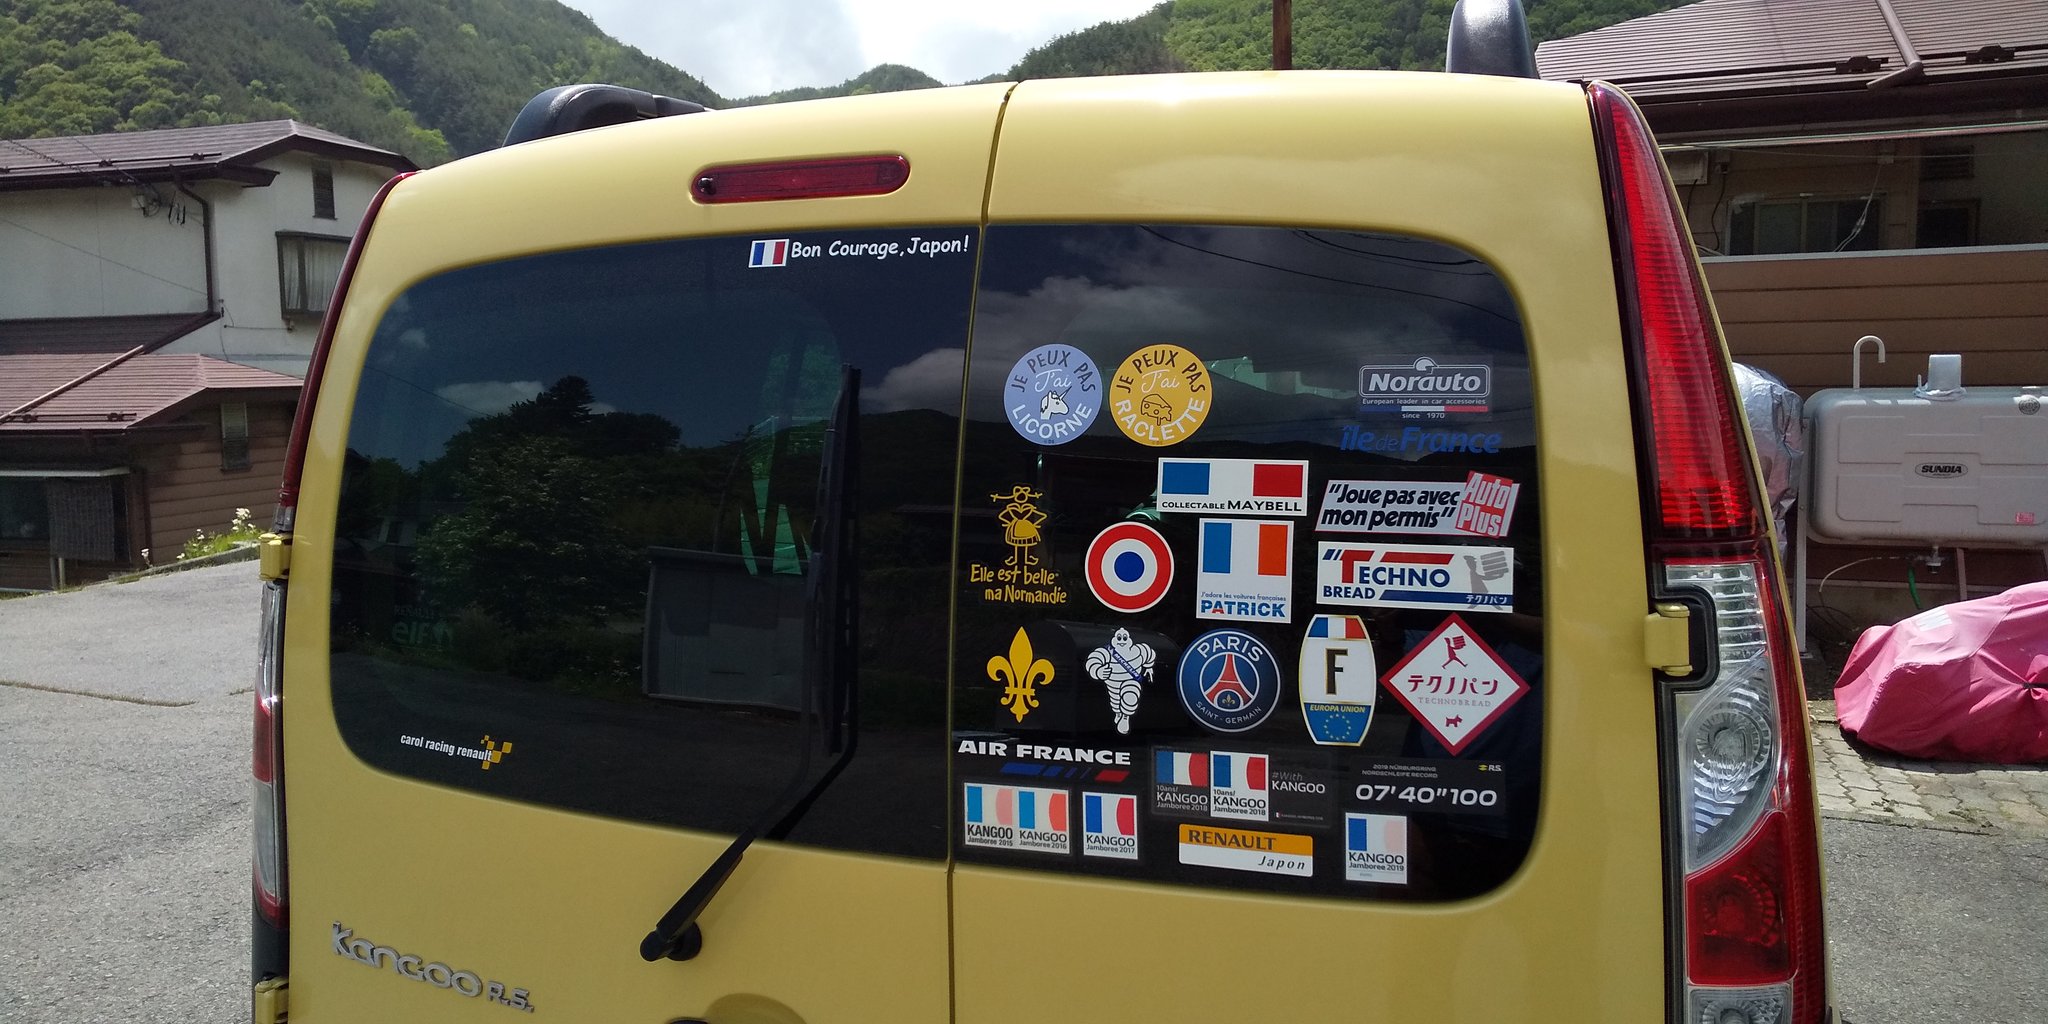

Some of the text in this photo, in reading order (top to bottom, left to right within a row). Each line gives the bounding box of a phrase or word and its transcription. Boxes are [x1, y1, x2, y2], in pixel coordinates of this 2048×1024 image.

[791, 241, 821, 258] Bon
[1011, 350, 1096, 393] JE PEUX PAS
[1116, 350, 1206, 393] JE PEUX PAS
[1035, 369, 1072, 393] J'ai
[1141, 369, 1180, 393] J'ai
[1368, 372, 1481, 392] Norauto
[1012, 403, 1092, 439] LICORNE
[1115, 398, 1206, 442] RACLETTE
[1400, 426, 1502, 453] France
[1921, 465, 1962, 473] SUNDIA
[1328, 484, 1461, 508] "Joue pas avec
[1464, 474, 1510, 509] Auto
[1162, 500, 1302, 512] COLLECTABLE MAYBELL
[1320, 506, 1456, 531] mon permis"
[1456, 503, 1502, 536] Plus
[970, 564, 1055, 585] Elle est belle
[1340, 549, 1451, 588] TECHNO
[985, 585, 1067, 604] ma Normandie
[1201, 591, 1222, 599] J'adore
[1257, 593, 1286, 602] françaises
[1323, 585, 1376, 600] BREAD
[1466, 595, 1507, 604] テクノパン
[1200, 600, 1286, 618] PATRICK
[1197, 636, 1263, 662] PARIS
[1114, 652, 1139, 678] MICHELIN
[1325, 648, 1349, 695] F
[1407, 675, 1498, 696] テクノパン
[1310, 704, 1366, 713] EUROPA UNION
[1417, 697, 1491, 707] TECHNOBREAD
[400, 734, 492, 762] carol racing renault
[958, 740, 1131, 766] AIR FRANCE
[1272, 771, 1303, 781] #With
[1272, 780, 1326, 794] KANGOO
[1156, 792, 1208, 805] KANGOO
[1156, 801, 1191, 810] Jamboree
[1213, 796, 1266, 809] KANGOO
[1213, 806, 1266, 816] Jamboree 2018
[967, 824, 1013, 840] KANGOO
[1019, 830, 1067, 843] KANGOO
[1086, 834, 1135, 847] KANGOO
[1188, 829, 1276, 851] RENAULT
[967, 836, 1013, 847] Jamboree 2015
[1019, 839, 1067, 849] Jamboree 2016
[1086, 844, 1135, 854] Jamboree 2017
[1258, 855, 1306, 870] Japon
[1348, 852, 1404, 864] KANGOO
[1348, 862, 1404, 872] Jamboree 2019
[486, 980, 535, 1013] R.S.
